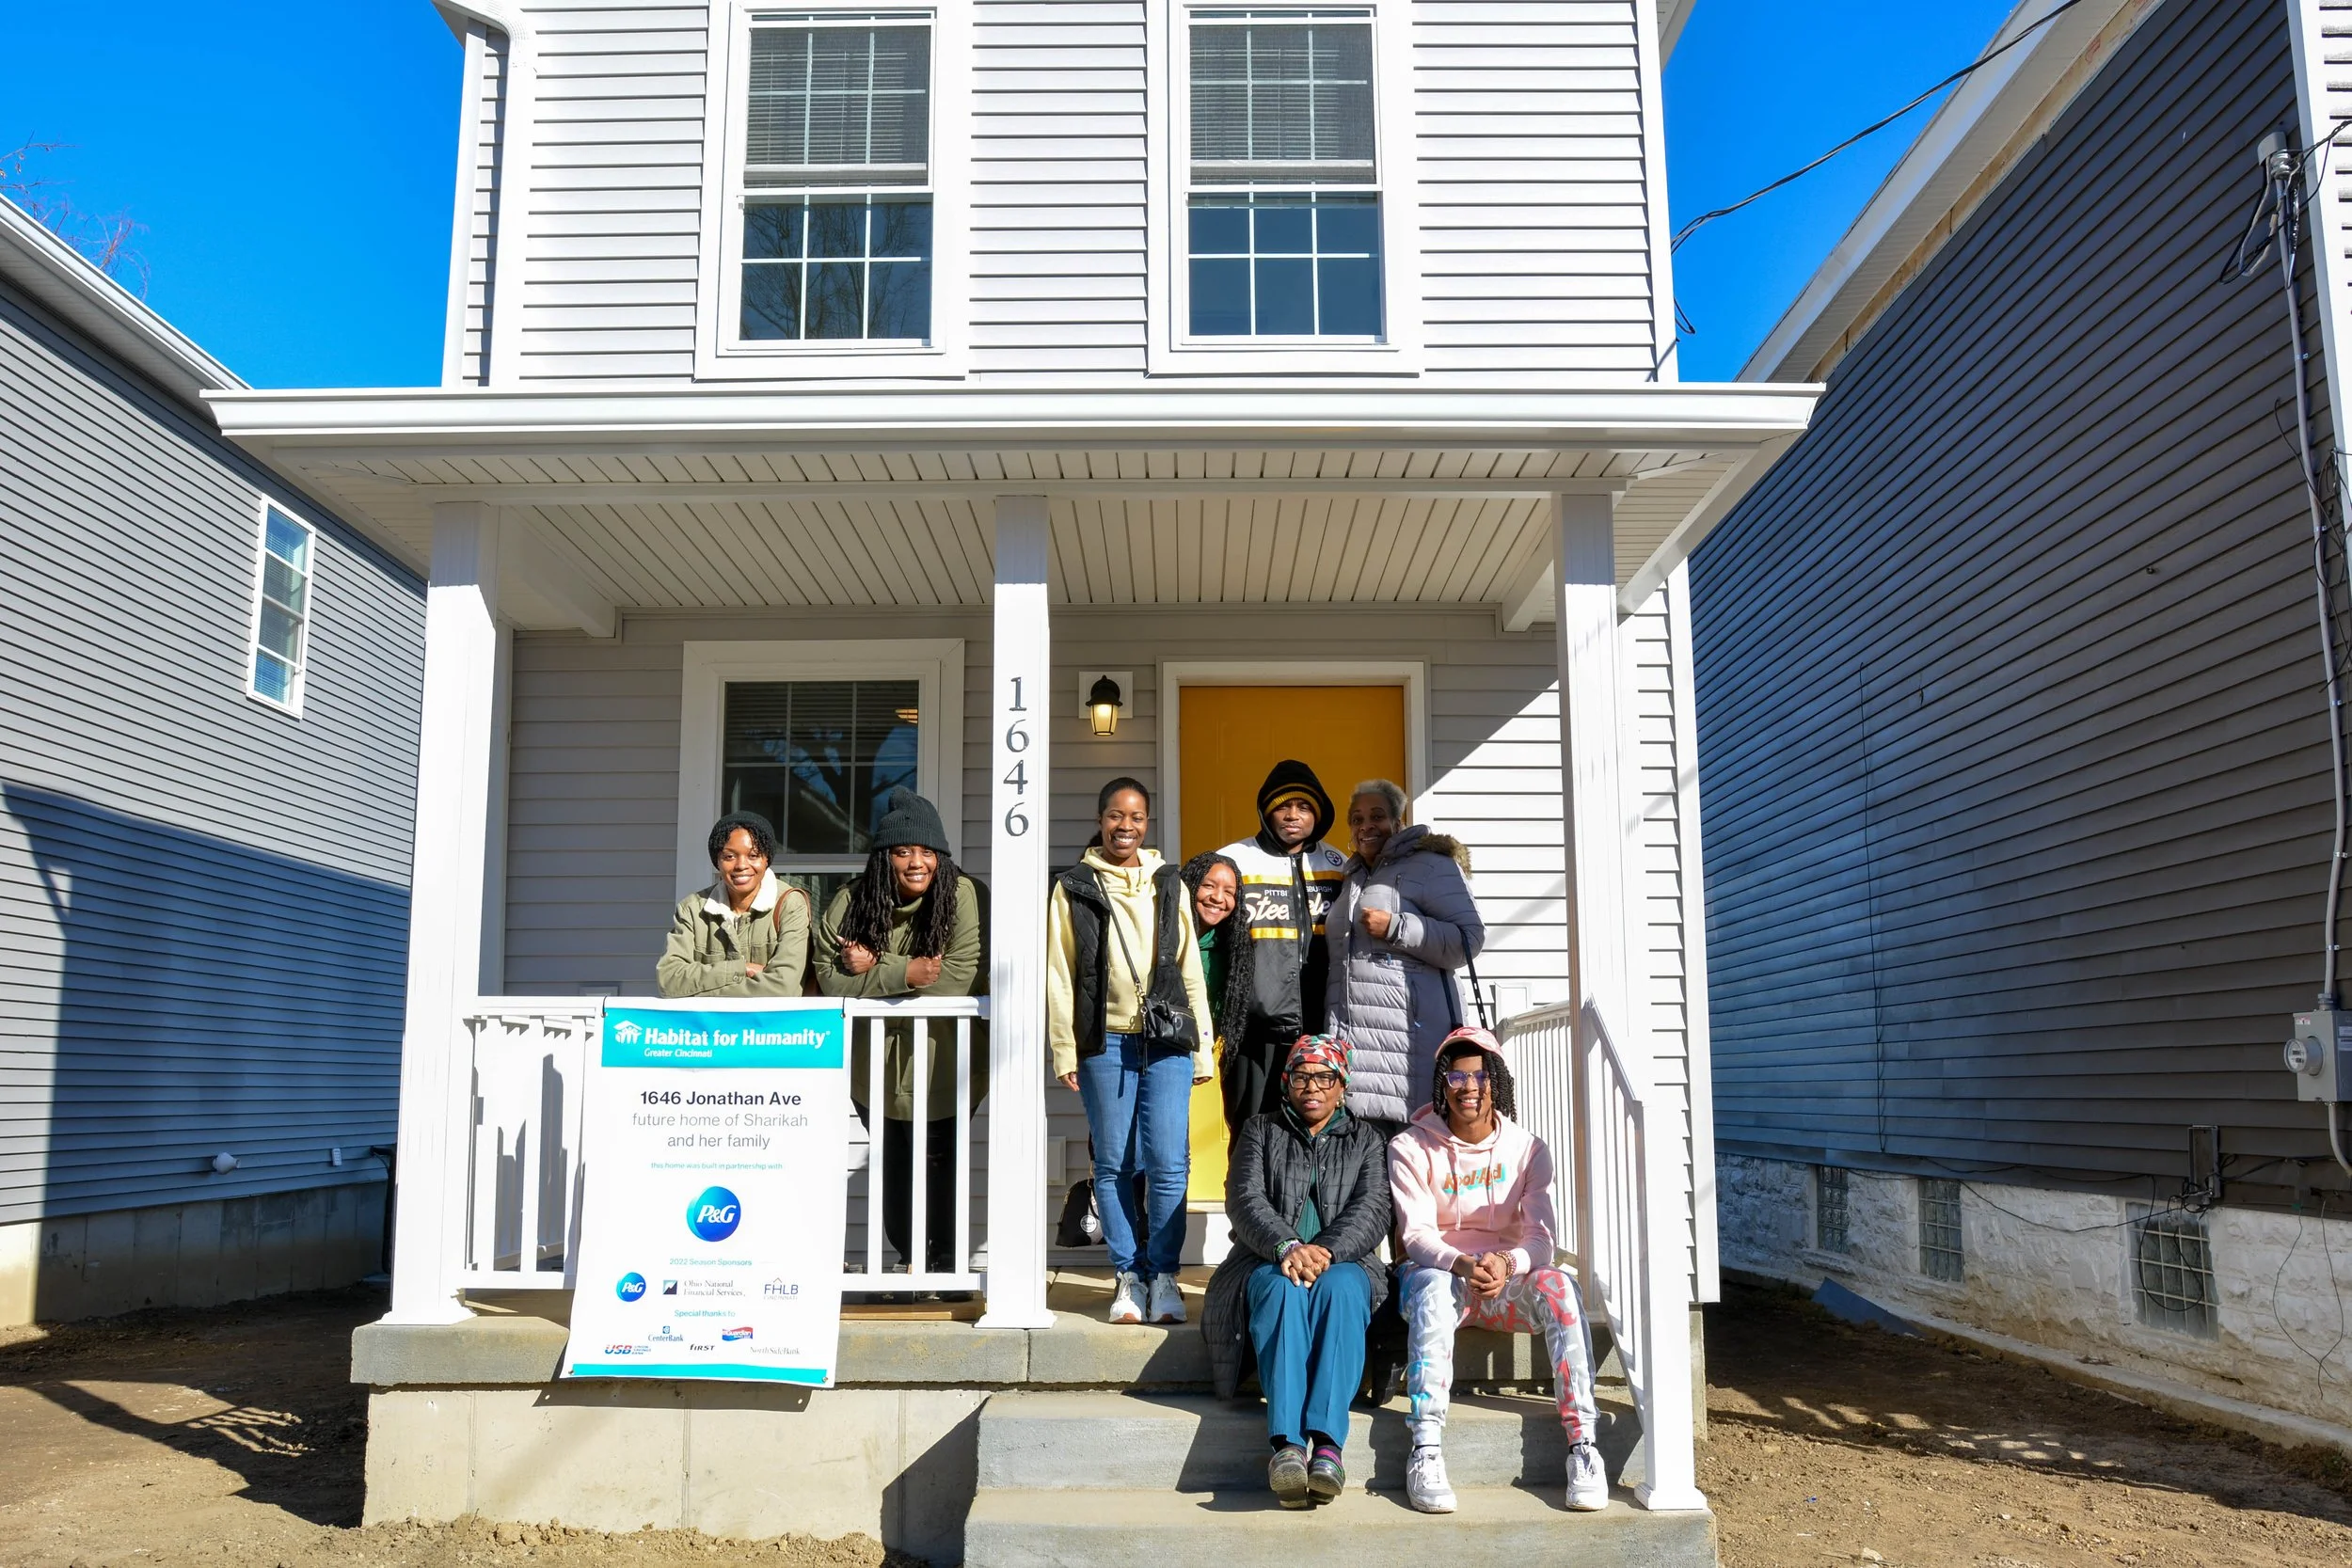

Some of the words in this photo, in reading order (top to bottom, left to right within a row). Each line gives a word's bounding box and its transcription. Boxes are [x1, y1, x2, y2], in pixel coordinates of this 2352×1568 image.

[1003, 676, 1030, 837] 1646
[644, 1027, 709, 1047] Habitat
[713, 1029, 739, 1047] for
[741, 1028, 826, 1050] Humanity
[644, 1048, 674, 1058] Greater
[675, 1049, 713, 1058] Cincinnati
[640, 1091, 682, 1105] 1646
[686, 1091, 765, 1106] Jonathan
[769, 1091, 802, 1106] Ave
[632, 1113, 676, 1127] future
[680, 1113, 721, 1127] home
[724, 1113, 741, 1127] of
[743, 1114, 809, 1128] Sharikah
[667, 1133, 694, 1148] and
[698, 1133, 723, 1148] her
[727, 1133, 771, 1150] family
[725, 1162, 768, 1171] partnership
[696, 1204, 737, 1224] P&G
[669, 1258, 689, 1266] 2022
[689, 1258, 717, 1266] Season
[717, 1258, 753, 1267] Sponsors
[621, 1281, 644, 1294] P&G
[683, 1279, 703, 1288] Ohio
[705, 1279, 734, 1289] National
[763, 1283, 800, 1295] FHLB
[683, 1288, 715, 1296] Financial
[674, 1309, 702, 1319] Special
[702, 1309, 726, 1318] thanks
[727, 1310, 737, 1319] to
[647, 1334, 685, 1342] CenterBank
[604, 1344, 633, 1354] USB
